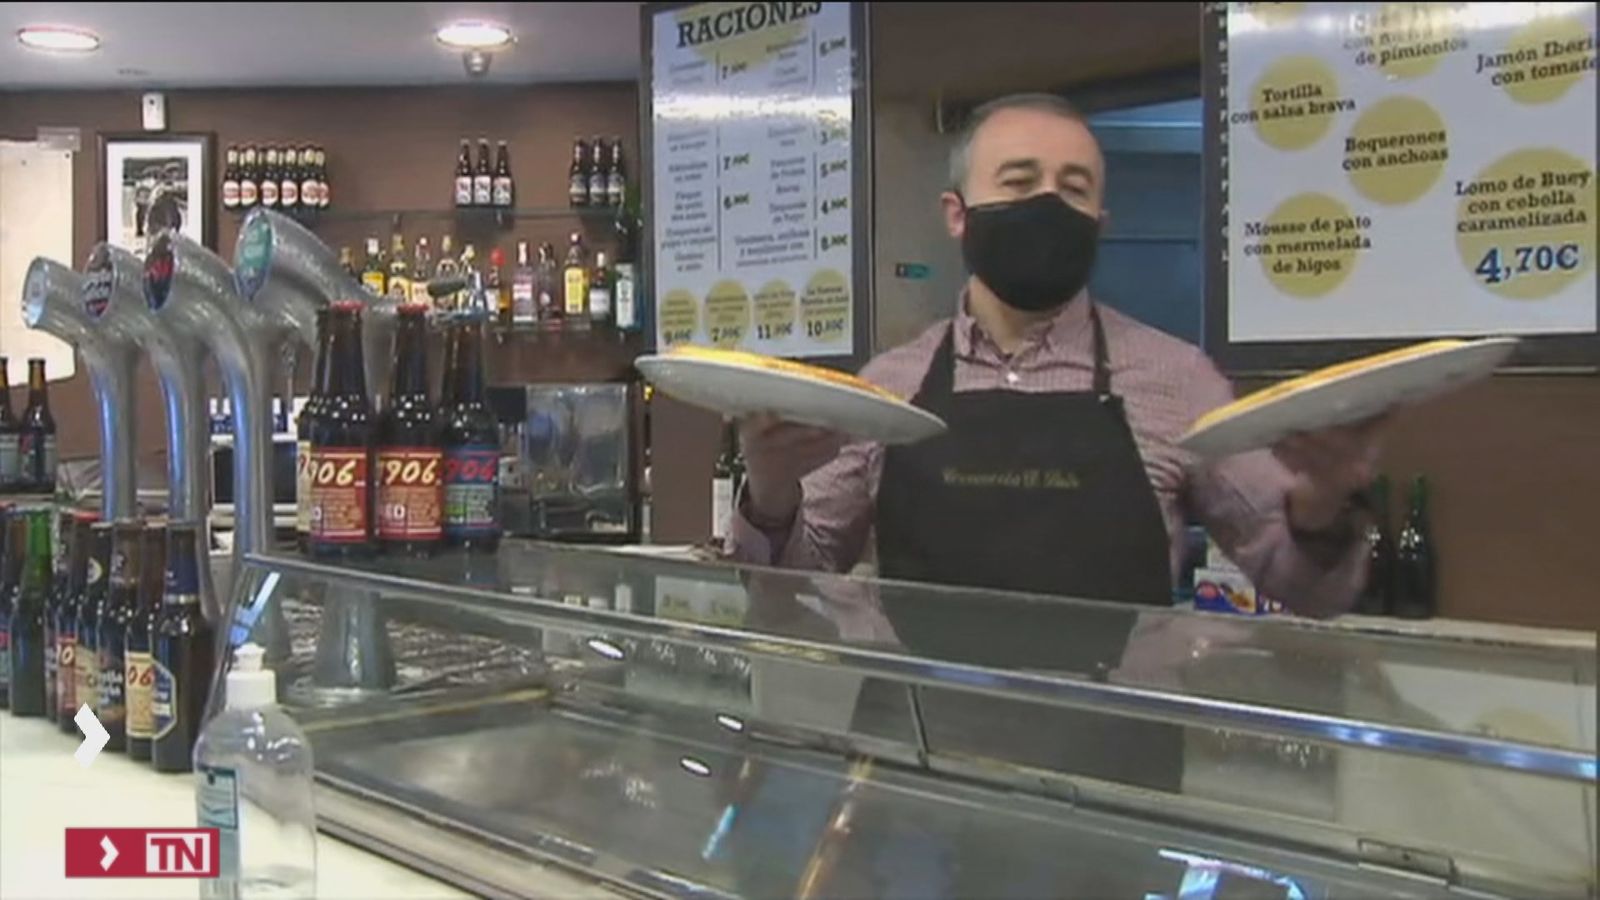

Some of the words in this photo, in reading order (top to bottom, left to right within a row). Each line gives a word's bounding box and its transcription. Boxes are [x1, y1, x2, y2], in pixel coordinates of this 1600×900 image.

[677, 2, 822, 47] RACIONES
[1356, 51, 1376, 66] de
[1380, 38, 1468, 66] pimientos
[1476, 48, 1538, 74] Jamón
[1491, 67, 1526, 86] con
[1263, 83, 1323, 103] Tortilla
[1231, 109, 1260, 125] con
[1263, 103, 1305, 121] salsa
[1308, 97, 1356, 116] brava
[1344, 129, 1446, 155] Boquerones
[1342, 156, 1373, 172] con
[1376, 147, 1449, 168] anchoas
[1455, 178, 1509, 196] Lomo
[1513, 174, 1536, 190] de
[1541, 170, 1592, 192] Buey
[1468, 198, 1502, 214] con
[1506, 191, 1576, 212] cebolla
[1246, 221, 1307, 238] Mousse
[1310, 218, 1331, 233] de
[1335, 215, 1372, 234] pato
[1456, 210, 1588, 234] caramelizada
[1244, 241, 1273, 256] con
[1276, 235, 1372, 254] mermelada
[1272, 259, 1294, 274] de
[1296, 257, 1341, 276] higos
[1475, 244, 1580, 284] 4,70€
